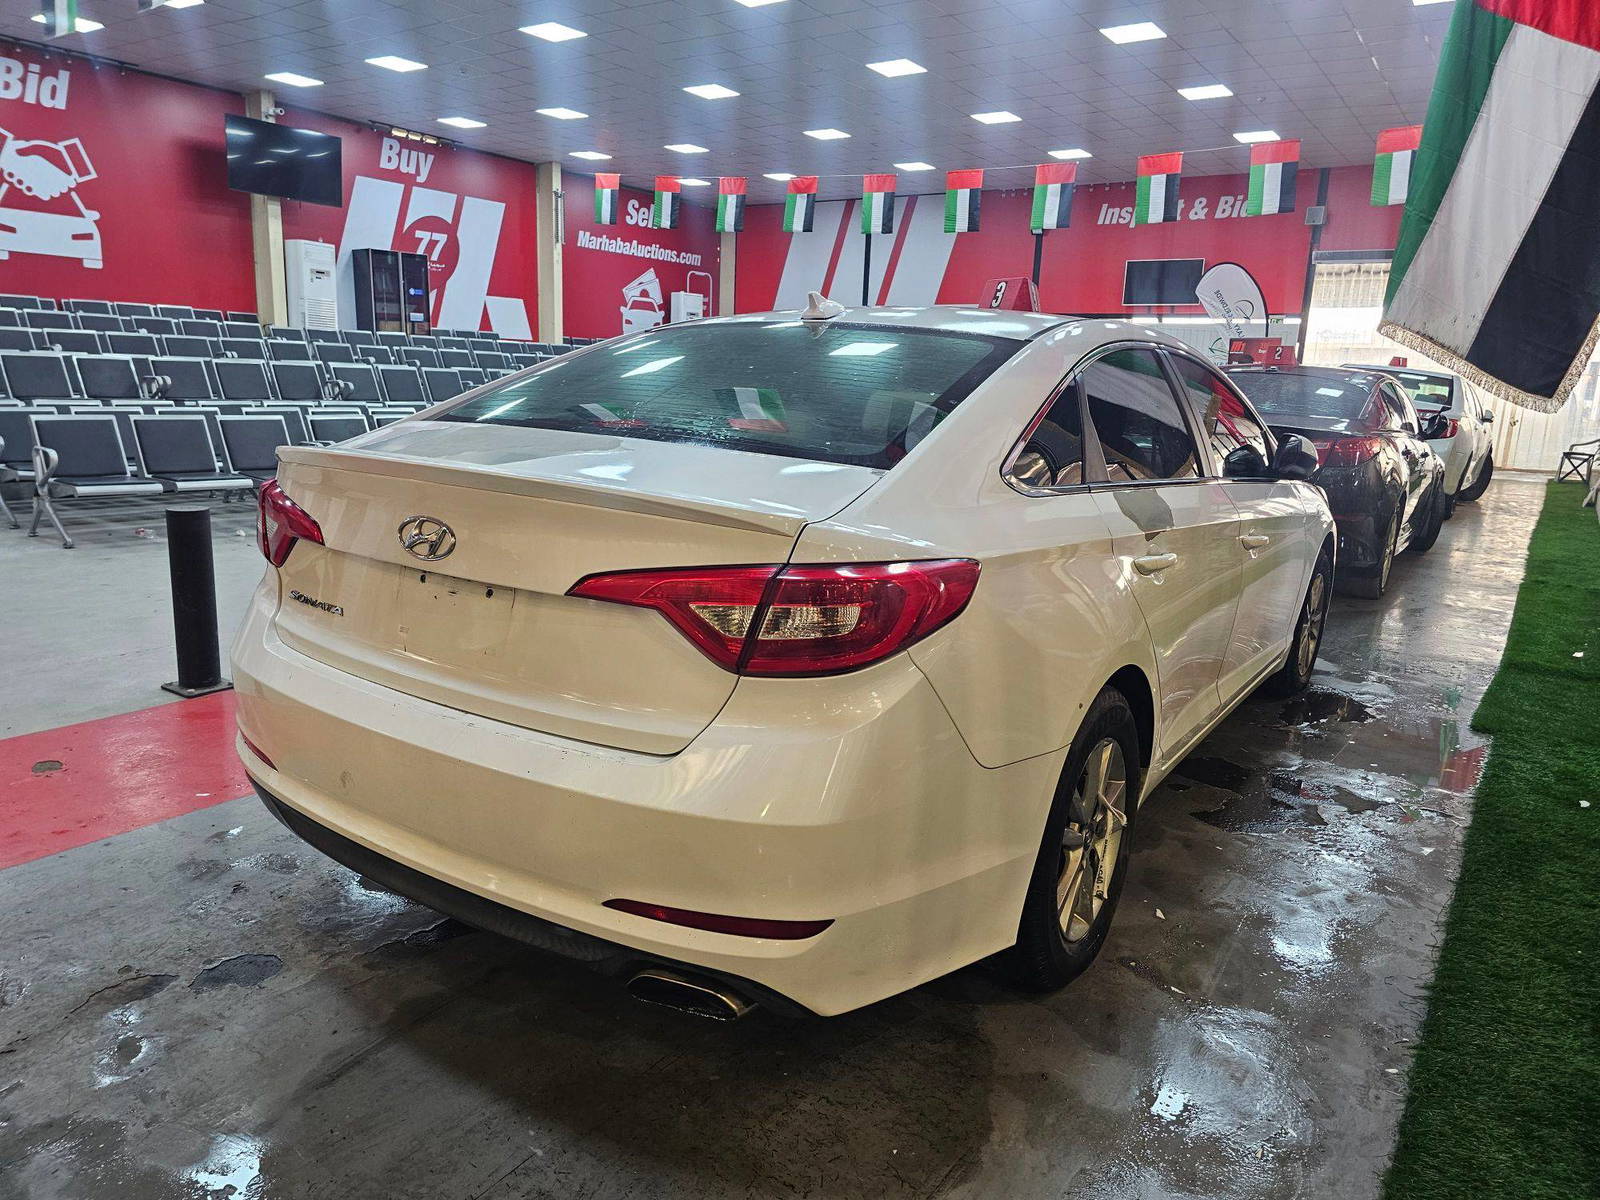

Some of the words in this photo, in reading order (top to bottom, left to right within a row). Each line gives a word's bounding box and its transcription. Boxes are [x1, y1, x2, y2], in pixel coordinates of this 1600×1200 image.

[0, 56, 70, 110] Bid
[379, 136, 435, 183] Buy
[625, 199, 658, 229] Sel
[1097, 198, 1185, 229] Inst
[1188, 197, 1209, 221] &
[415, 230, 448, 262] 77
[577, 230, 702, 266] MarhabaAuctions.com
[991, 281, 1007, 308] 3
[1274, 346, 1283, 360] 2
[289, 590, 344, 617] SONATA
